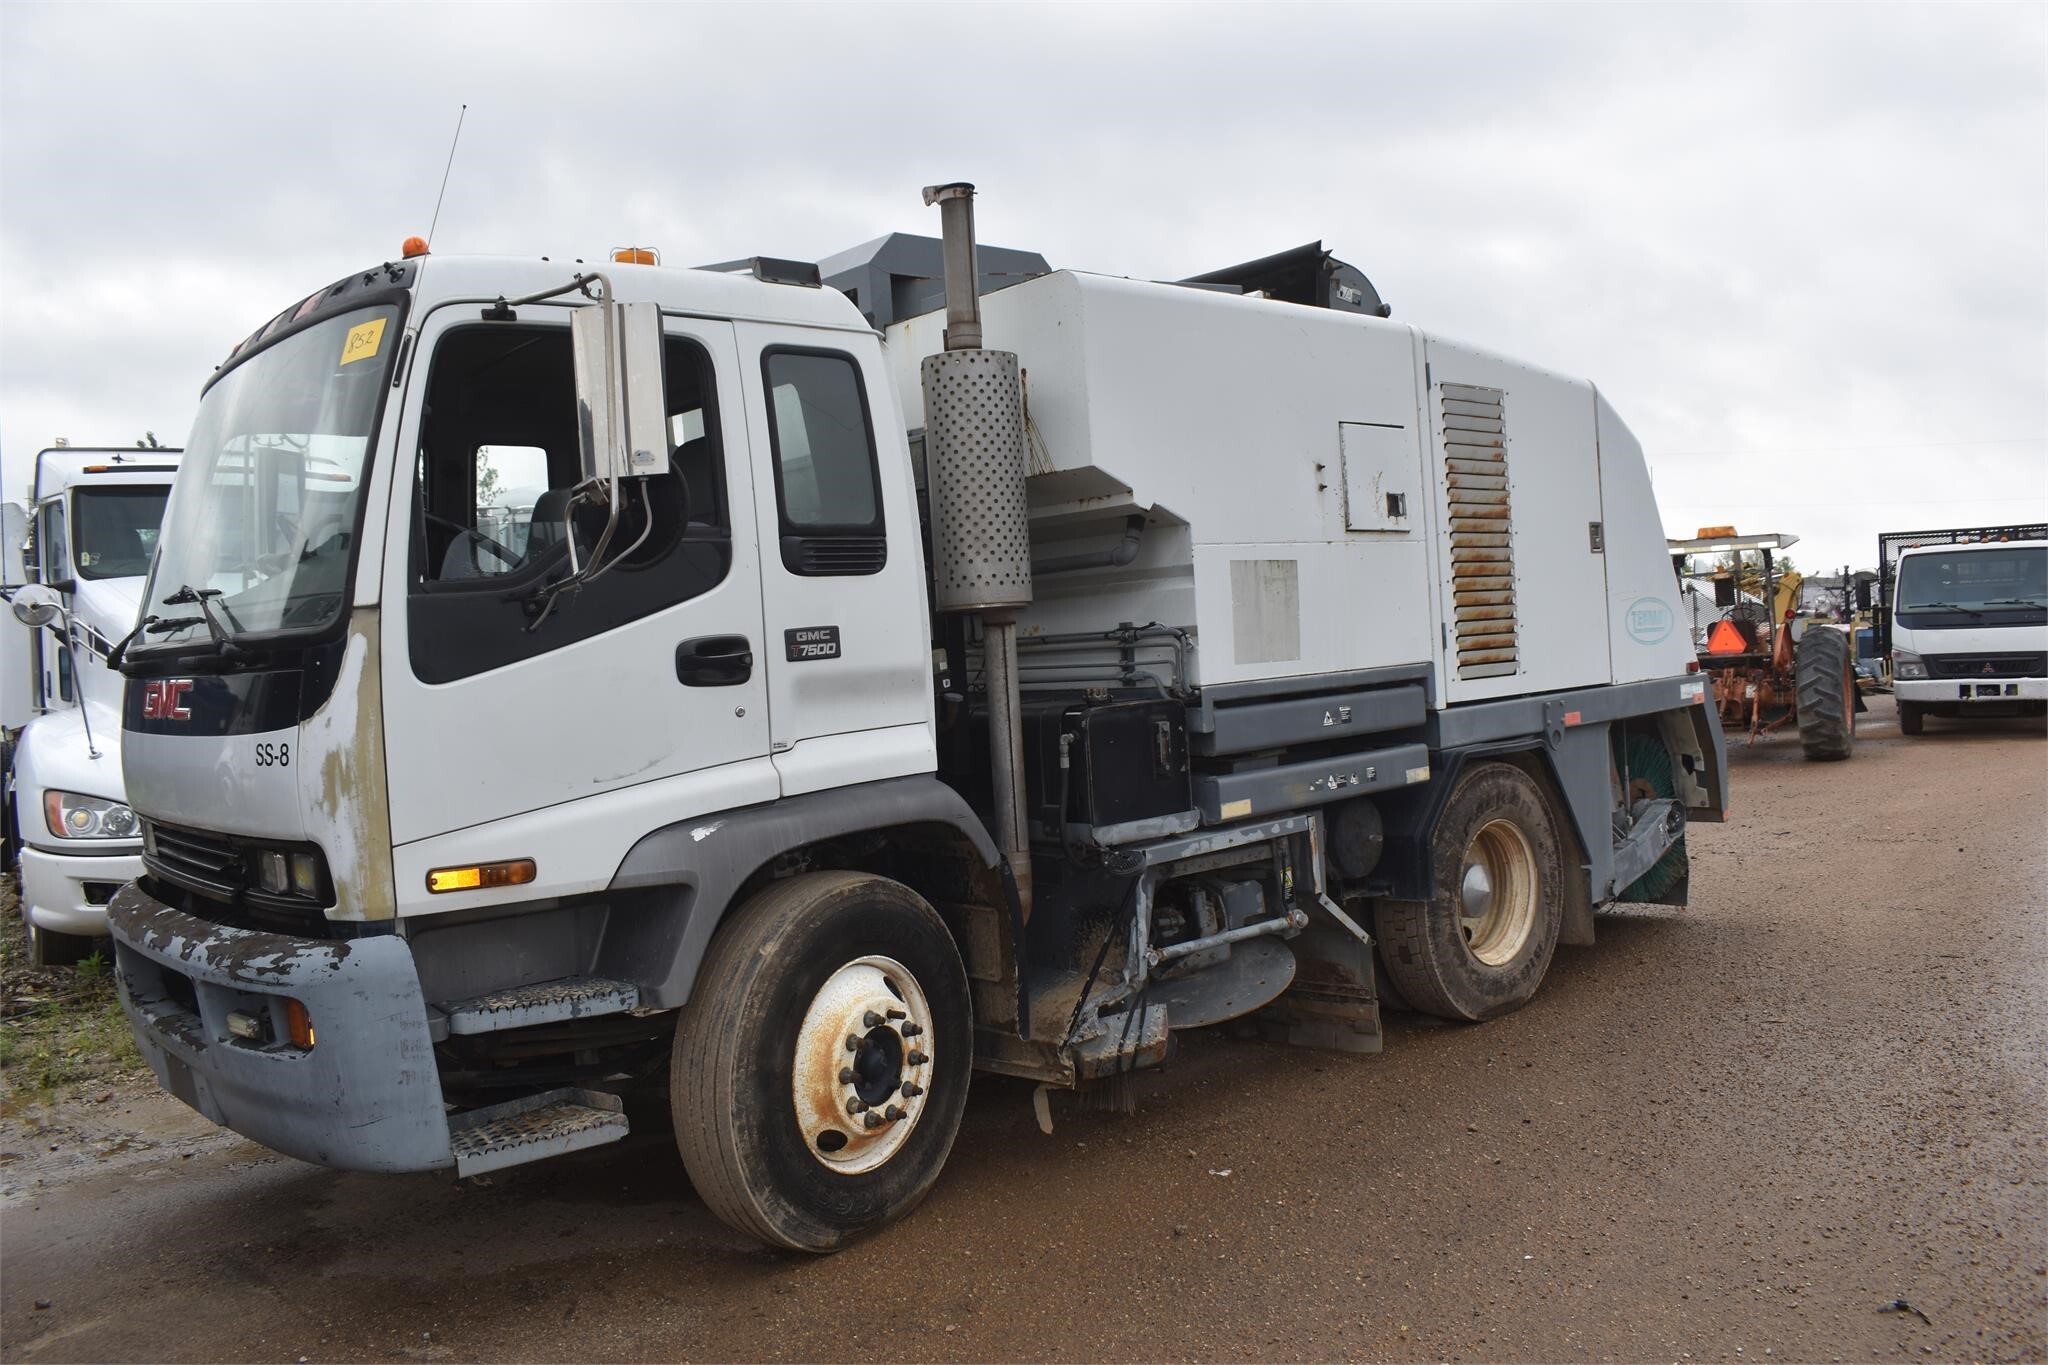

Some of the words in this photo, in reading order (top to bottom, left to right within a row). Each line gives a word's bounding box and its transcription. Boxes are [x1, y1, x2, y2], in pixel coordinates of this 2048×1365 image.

[347, 330, 375, 354] 852
[796, 630, 831, 641] GMC
[791, 642, 836, 657] T7500
[143, 679, 194, 720] GMC
[256, 743, 290, 767] SS-8
